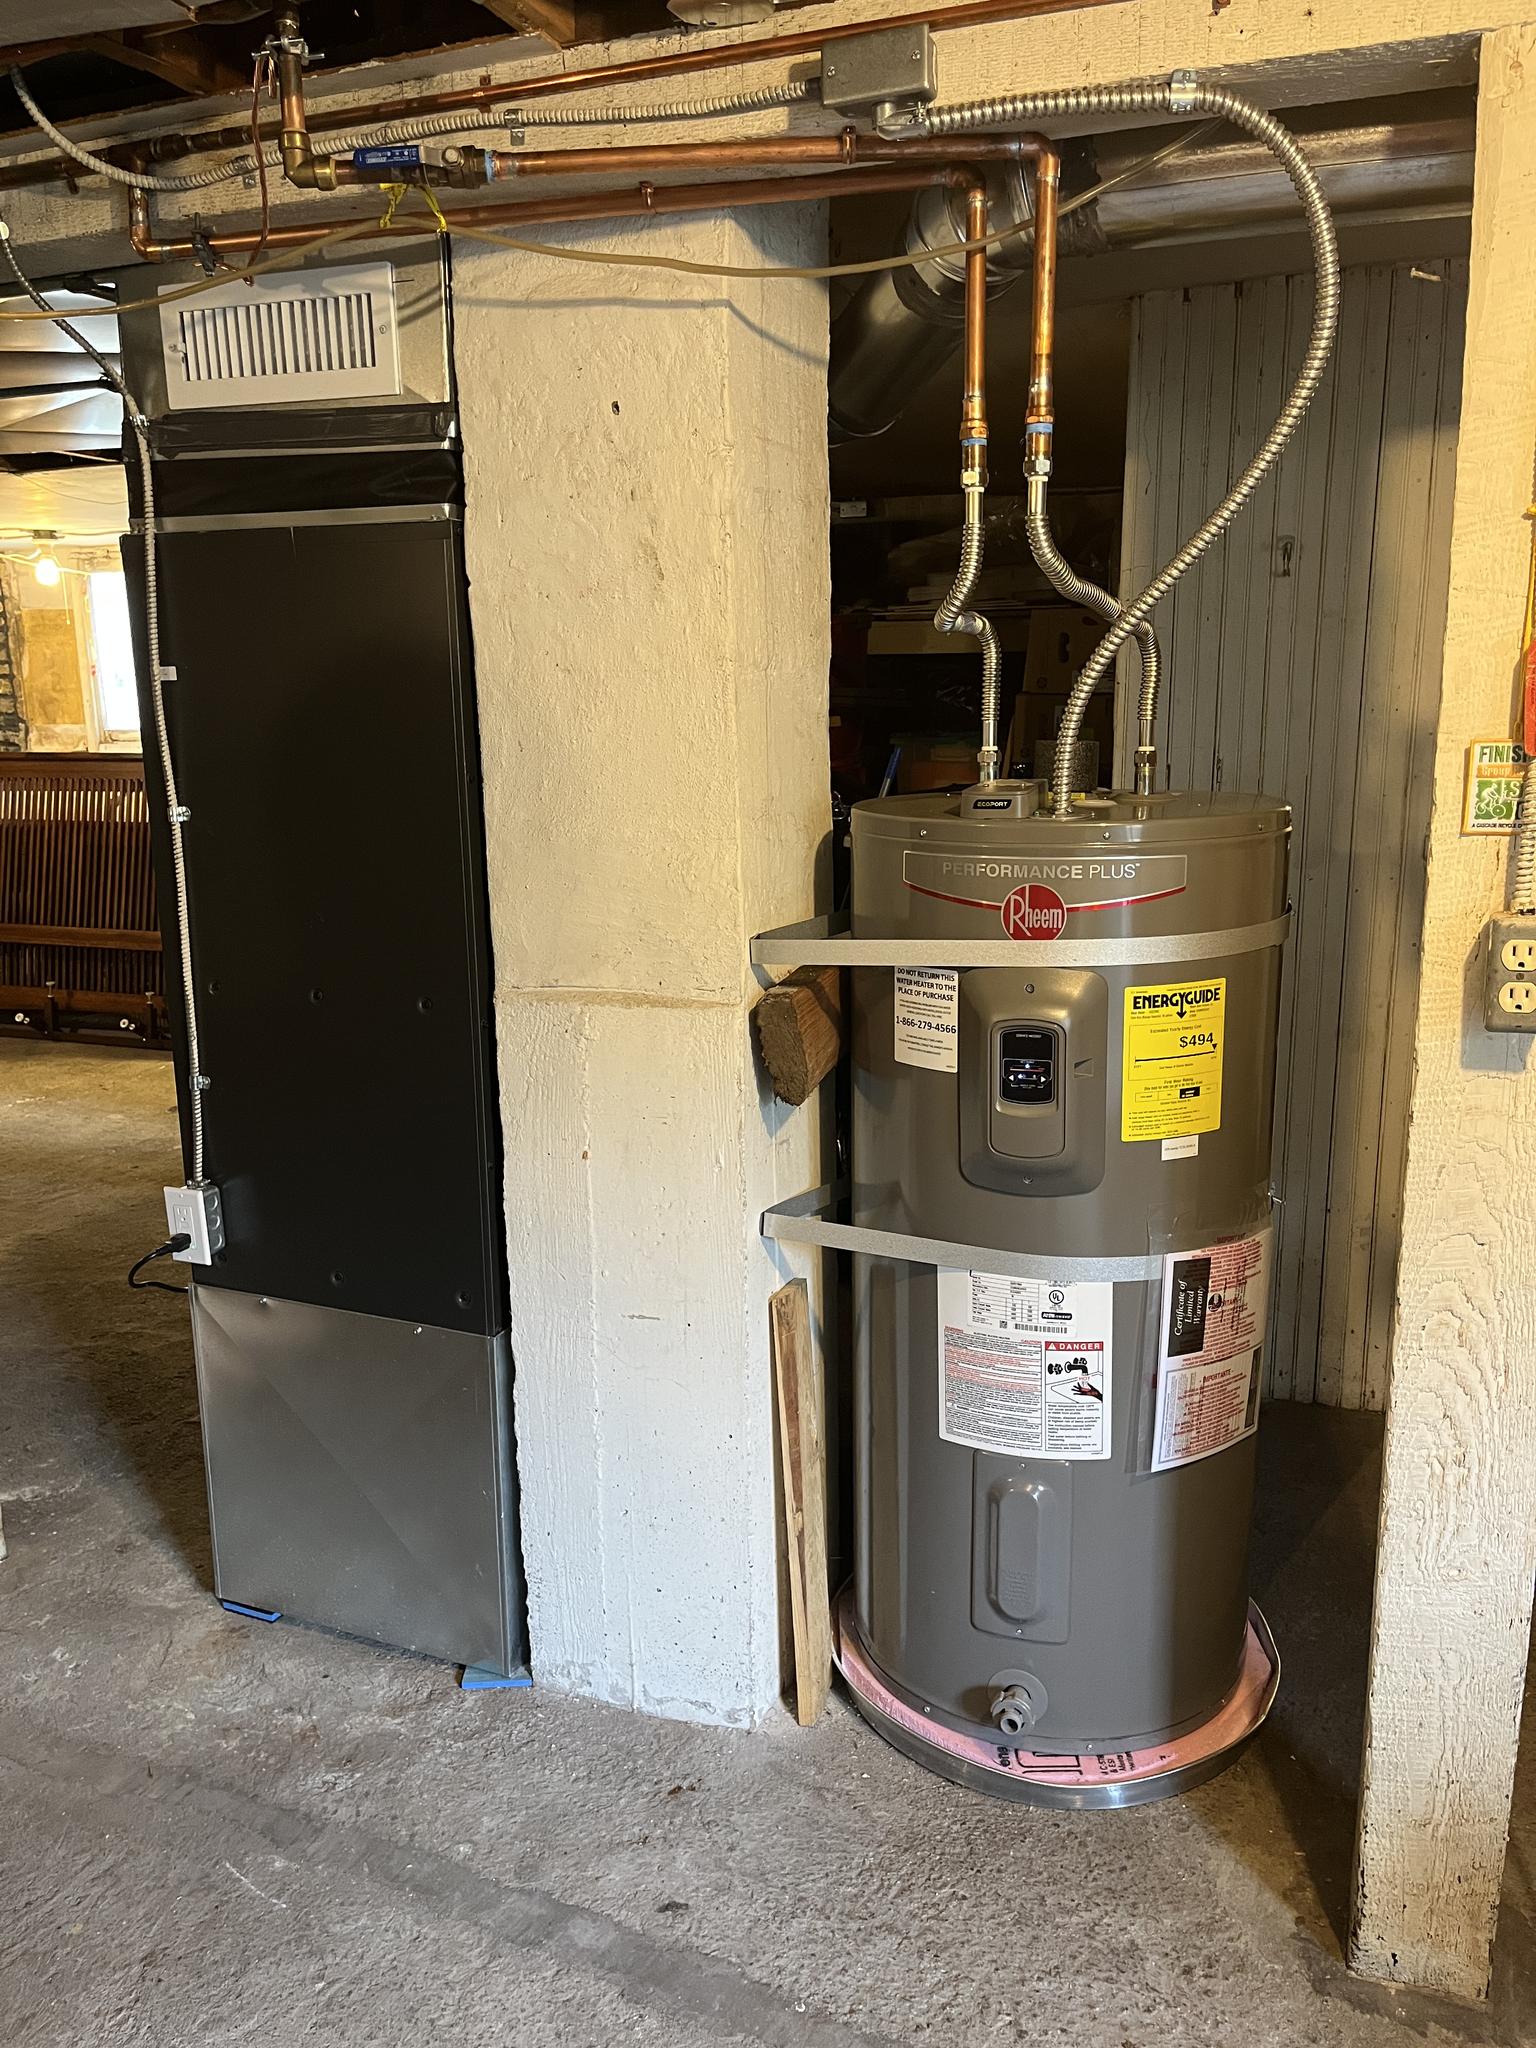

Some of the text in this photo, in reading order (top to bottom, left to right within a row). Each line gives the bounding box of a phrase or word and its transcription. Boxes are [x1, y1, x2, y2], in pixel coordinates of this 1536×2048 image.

[942, 862, 1083, 880] PERFORMANCE
[1009, 884, 1063, 937] Rheem
[897, 967, 955, 982] DO NOT RETURN THIS
[896, 977, 957, 992] WATER HEATER TO THE
[897, 986, 955, 1002] PLACE OF PURCHASE
[1132, 986, 1222, 1011] ENERGYGUIDE
[895, 1015, 957, 1034] 1-866-279-4566
[1179, 1032, 1214, 1049] $494
[1174, 1278, 1188, 1336] Certificate of
[1184, 1290, 1195, 1323] Limited
[1193, 1285, 1205, 1325] Warranty
[1059, 1342, 1101, 1351] DANGER
